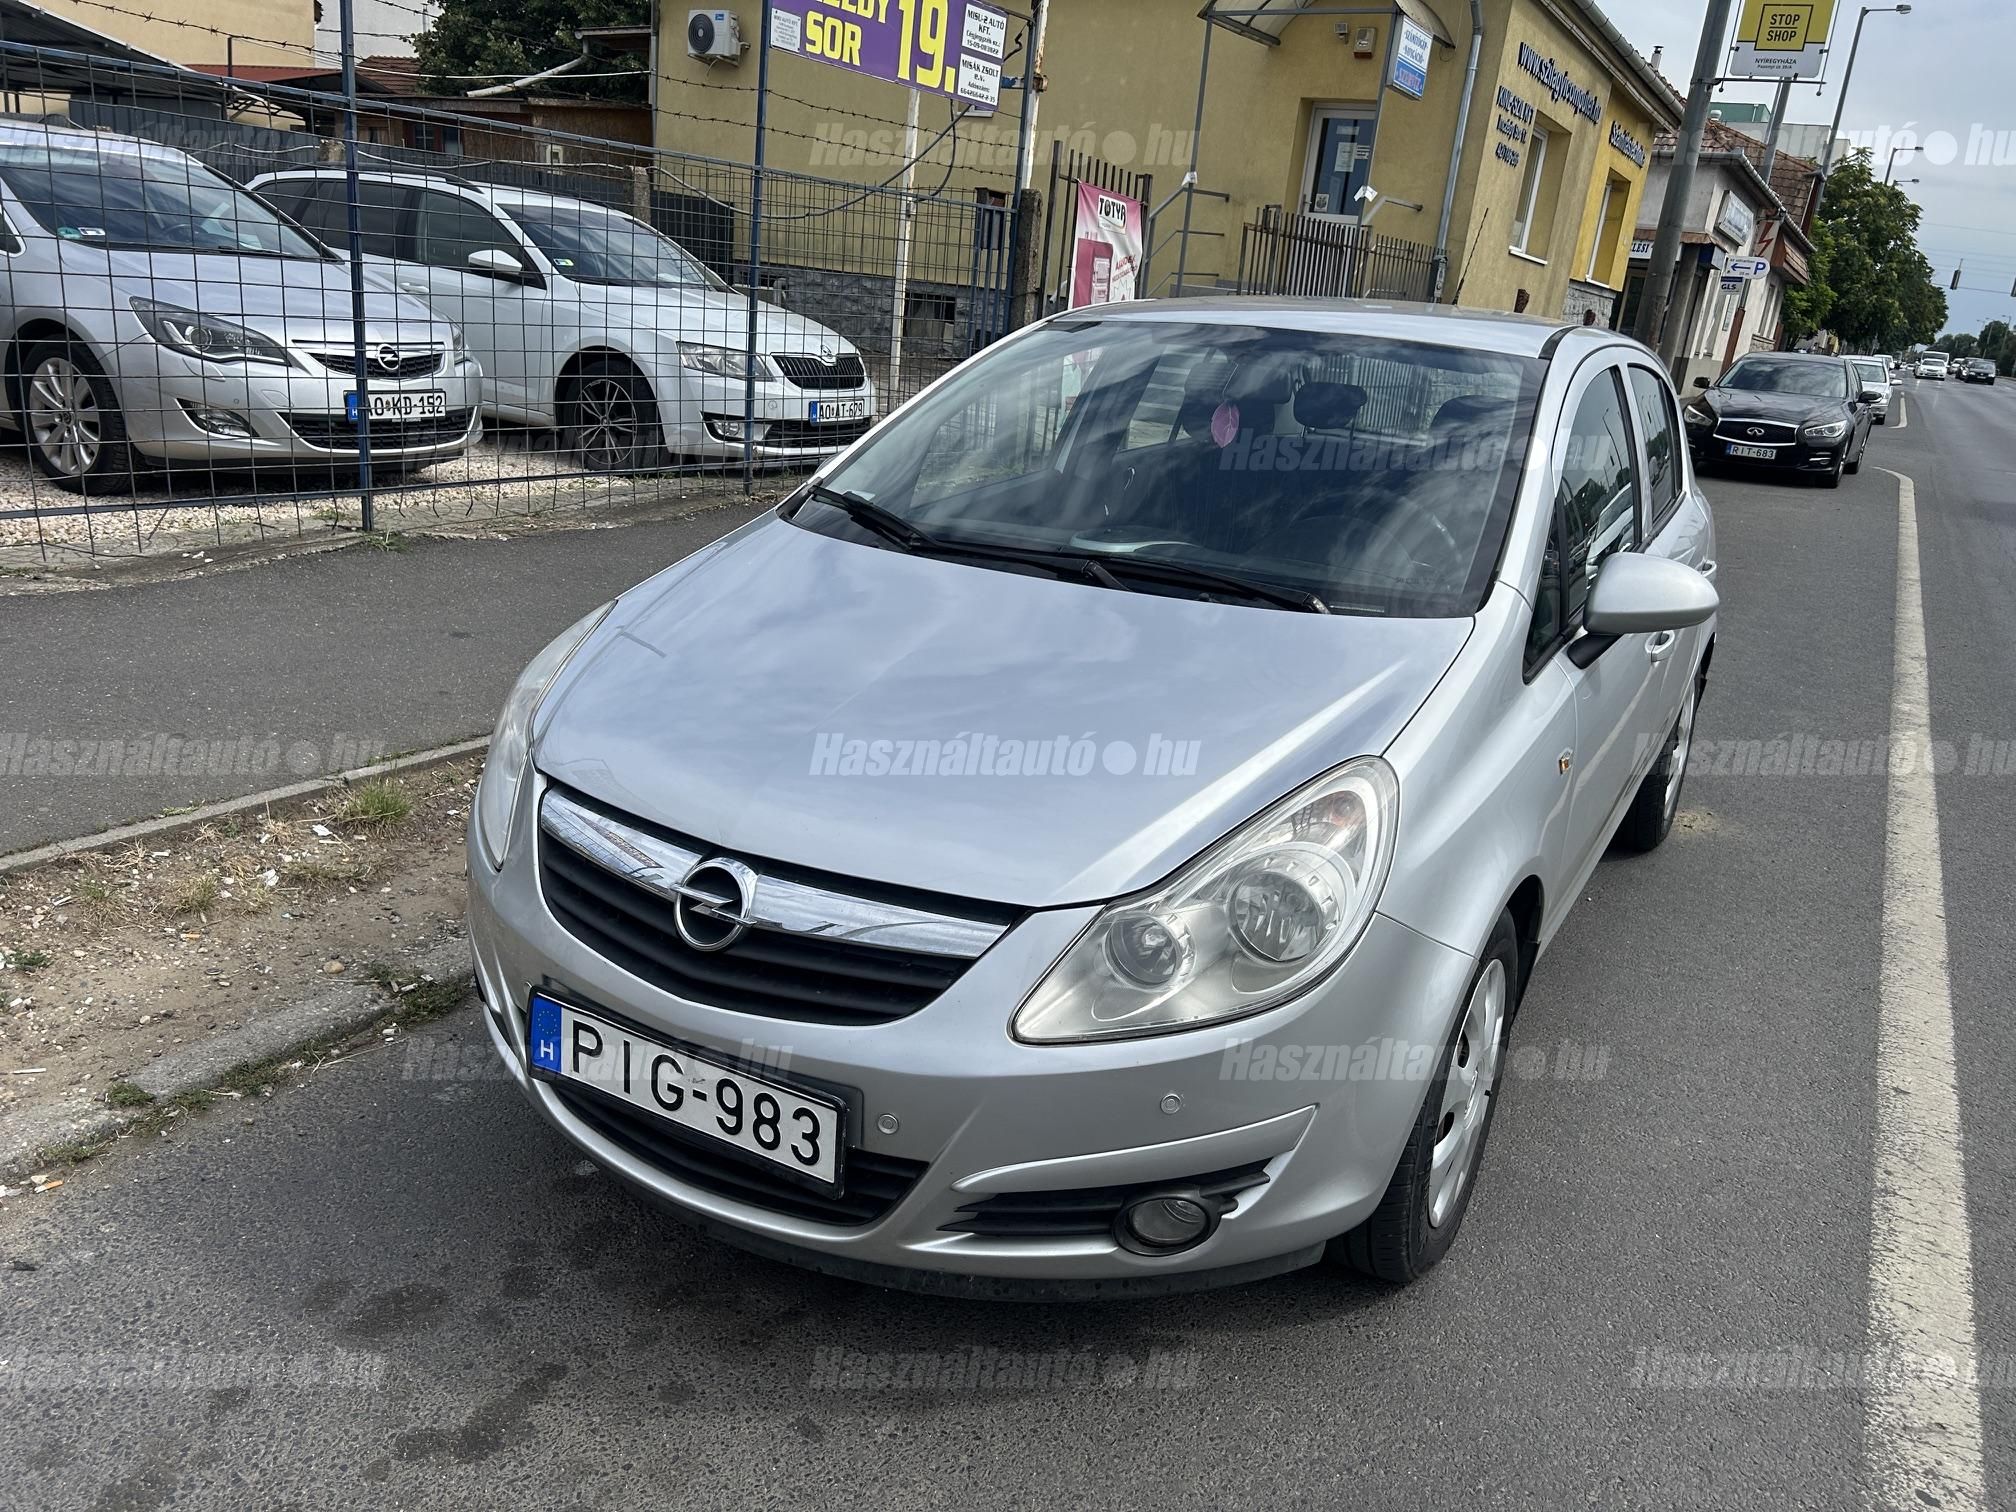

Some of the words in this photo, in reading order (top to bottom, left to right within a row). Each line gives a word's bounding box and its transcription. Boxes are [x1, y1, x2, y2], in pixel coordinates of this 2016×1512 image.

[989, 18, 1005, 30] AUTÓ
[1769, 14, 1800, 25] STOP
[978, 24, 991, 35] KFT.
[805, 11, 861, 66] SOR
[1766, 30, 1797, 41] SHOP
[981, 66, 999, 77] ZSOLT
[1732, 446, 1774, 459] RIT-683
[540, 1040, 554, 1061] H
[572, 1018, 821, 1167] PIG-983
